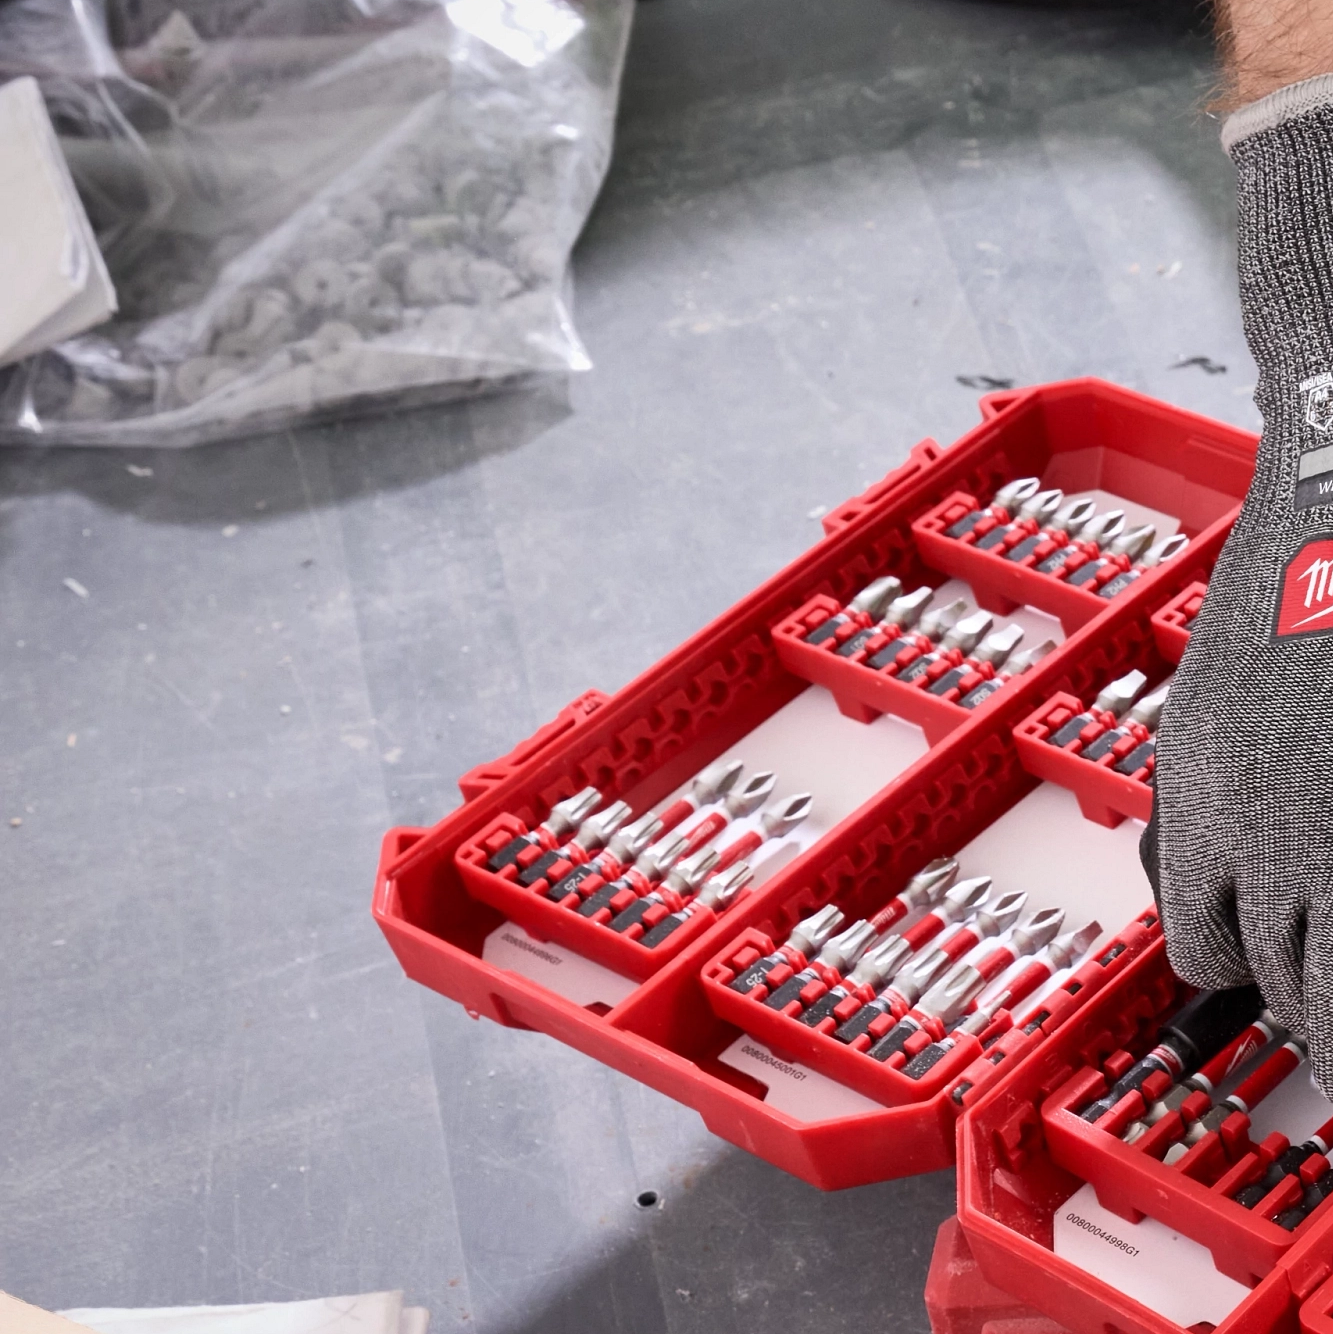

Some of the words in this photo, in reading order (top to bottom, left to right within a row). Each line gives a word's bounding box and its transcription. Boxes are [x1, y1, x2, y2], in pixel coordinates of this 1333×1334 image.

[1315, 390, 1328, 402] A4
[741, 1045, 807, 1081] 00800045001G1
[1066, 1213, 1140, 1257] 00800044998G1
